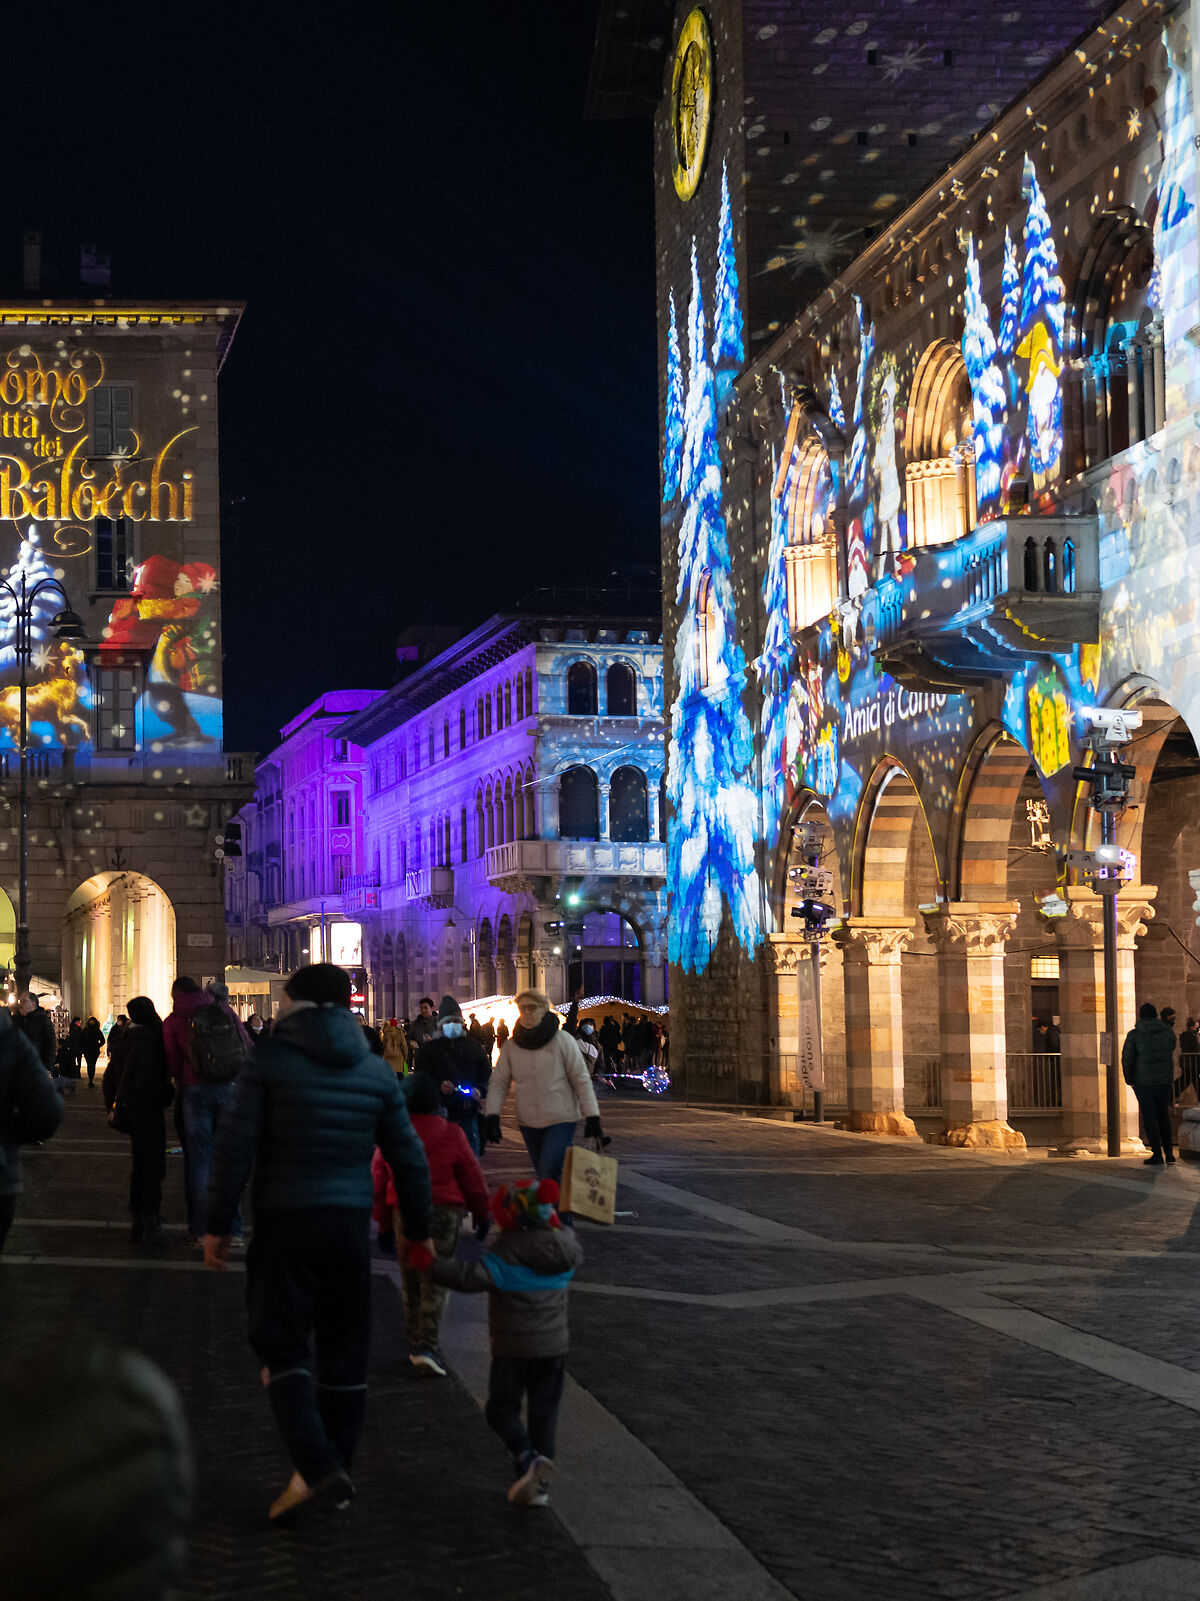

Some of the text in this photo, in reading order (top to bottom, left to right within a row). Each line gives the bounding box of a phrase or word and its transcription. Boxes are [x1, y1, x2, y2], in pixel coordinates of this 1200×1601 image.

[33, 435, 62, 457] dei
[844, 685, 947, 740] Amici di Como
